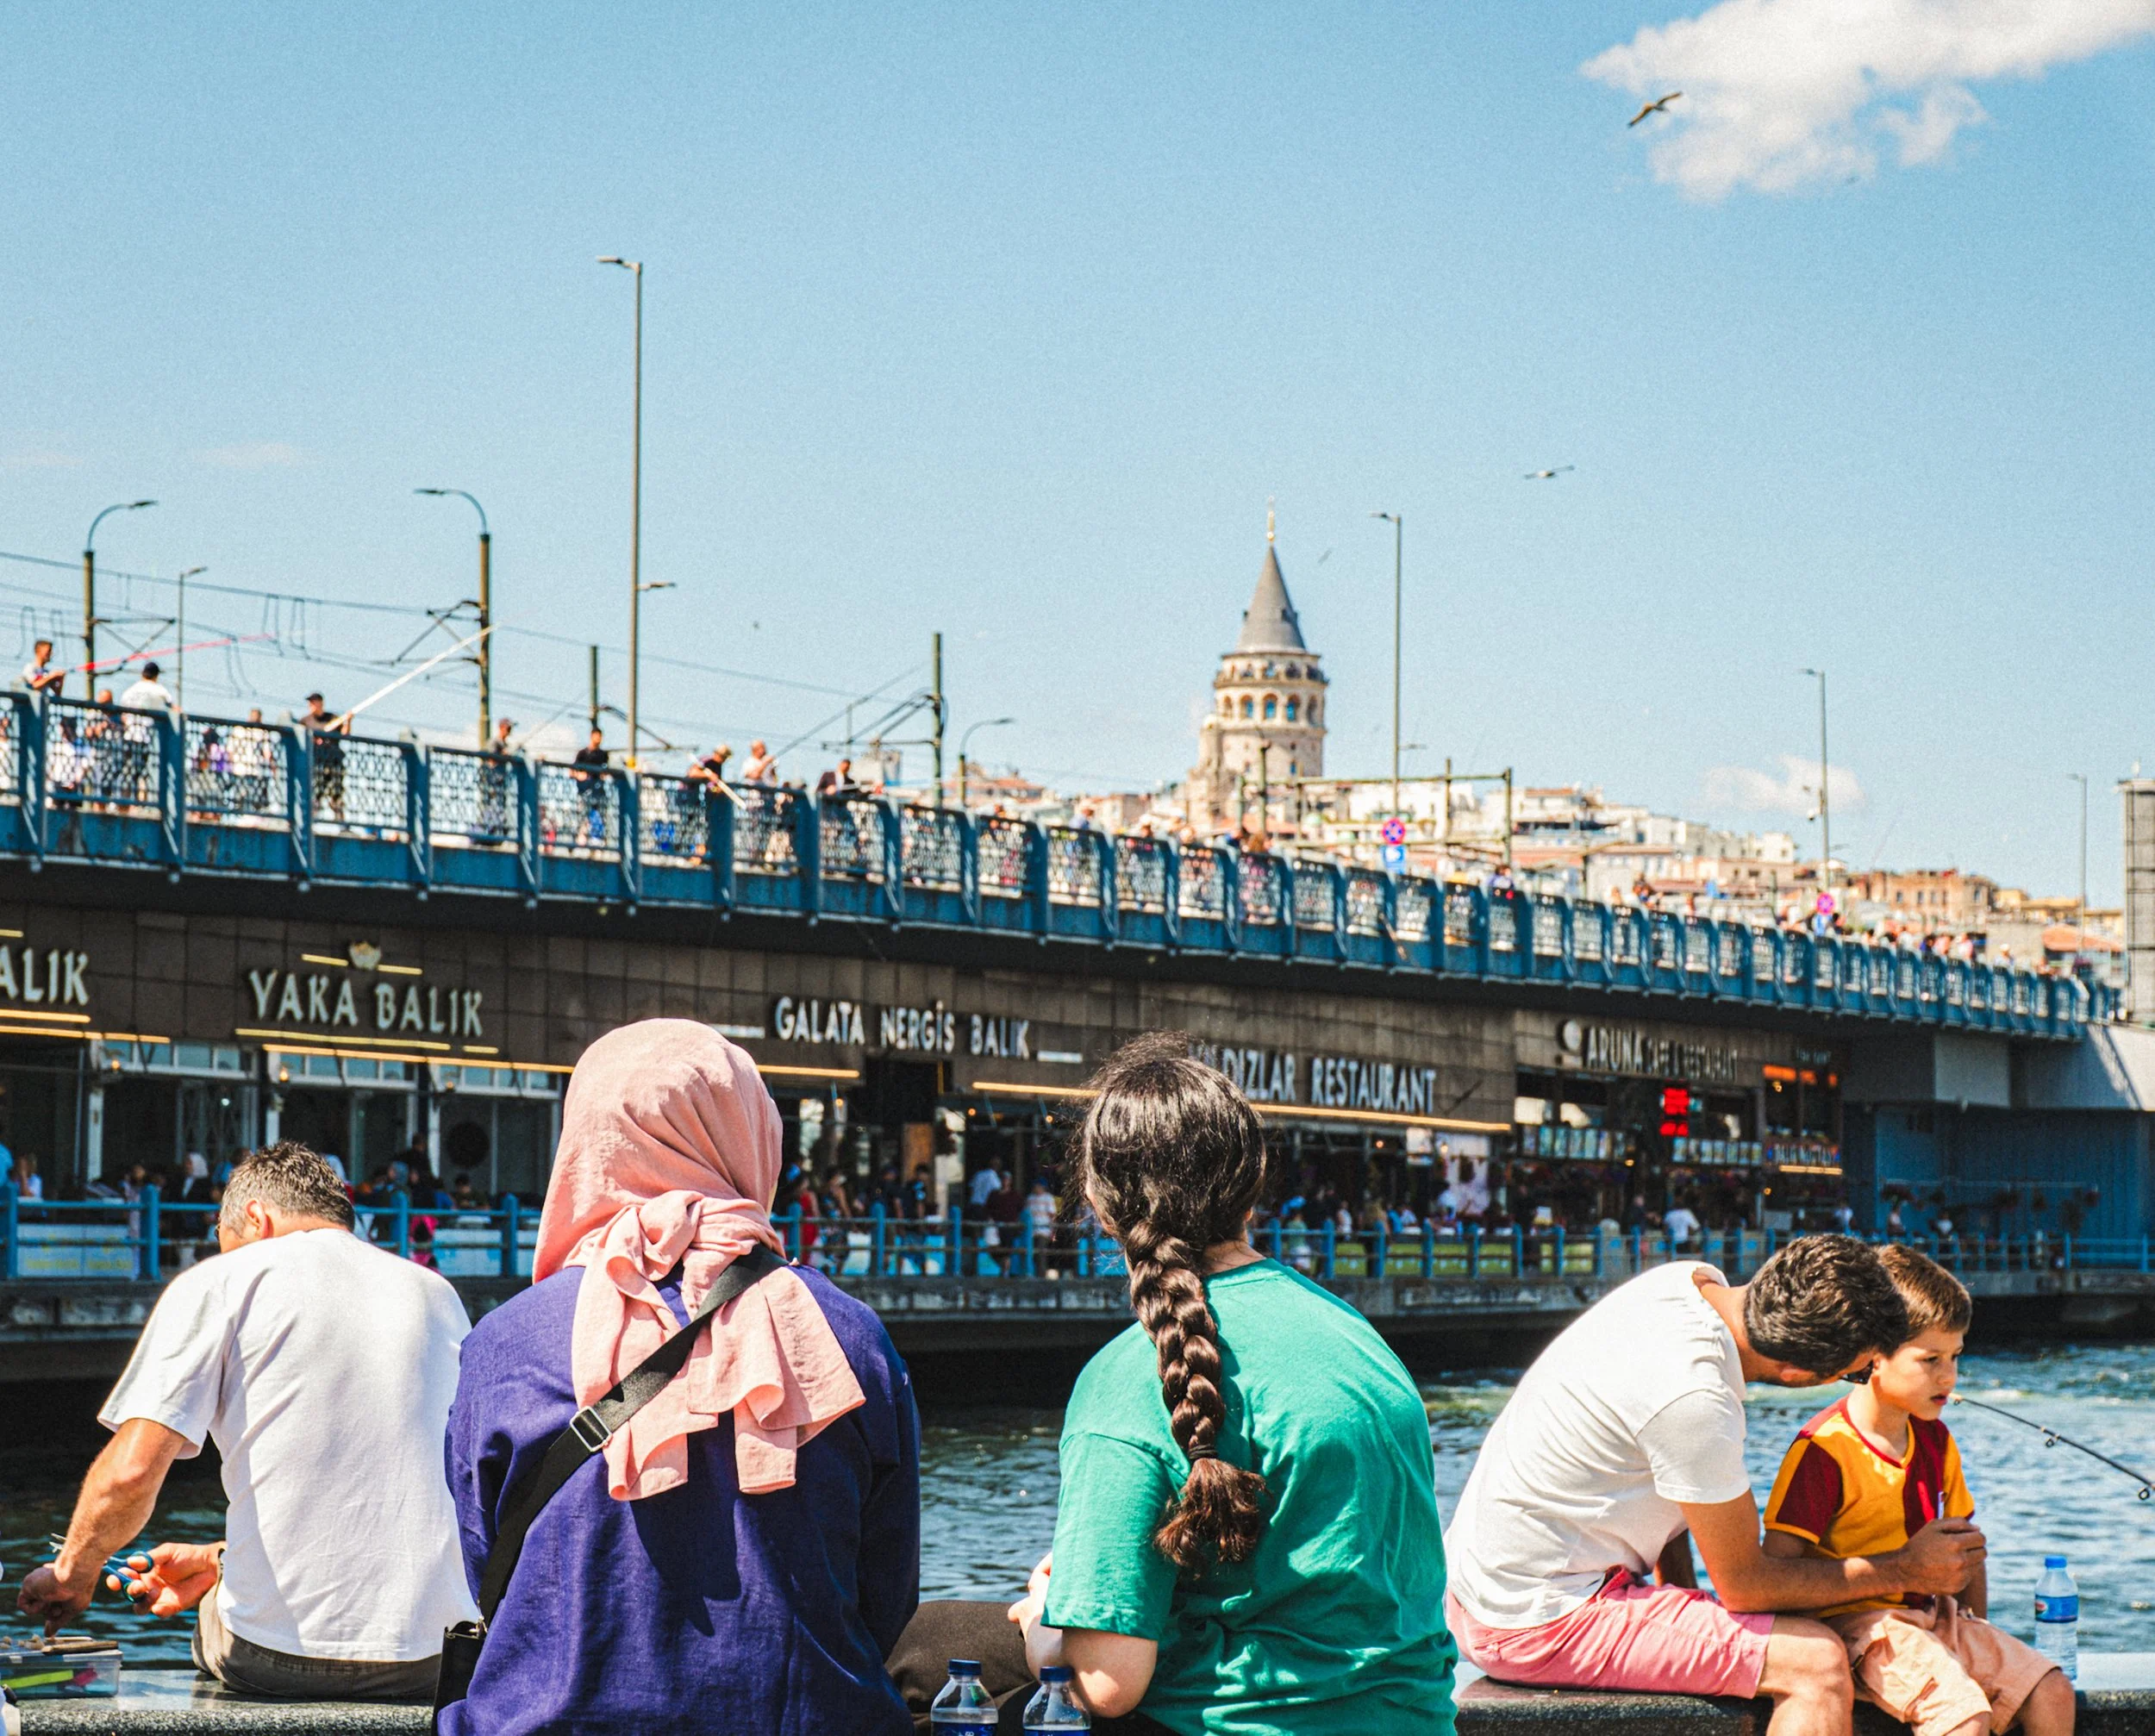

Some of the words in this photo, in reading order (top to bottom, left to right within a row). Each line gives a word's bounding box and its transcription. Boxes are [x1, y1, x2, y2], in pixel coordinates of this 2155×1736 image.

[0, 946, 90, 1006] ALIK
[249, 970, 358, 1026] YAKA
[375, 983, 483, 1035] BALIK
[776, 996, 865, 1046] GALATA
[880, 1000, 955, 1052] NERGİS
[971, 1014, 1029, 1059] BALIK
[1587, 1025, 1644, 1073] ARUNA
[1311, 1057, 1436, 1113] RESTAURANT
